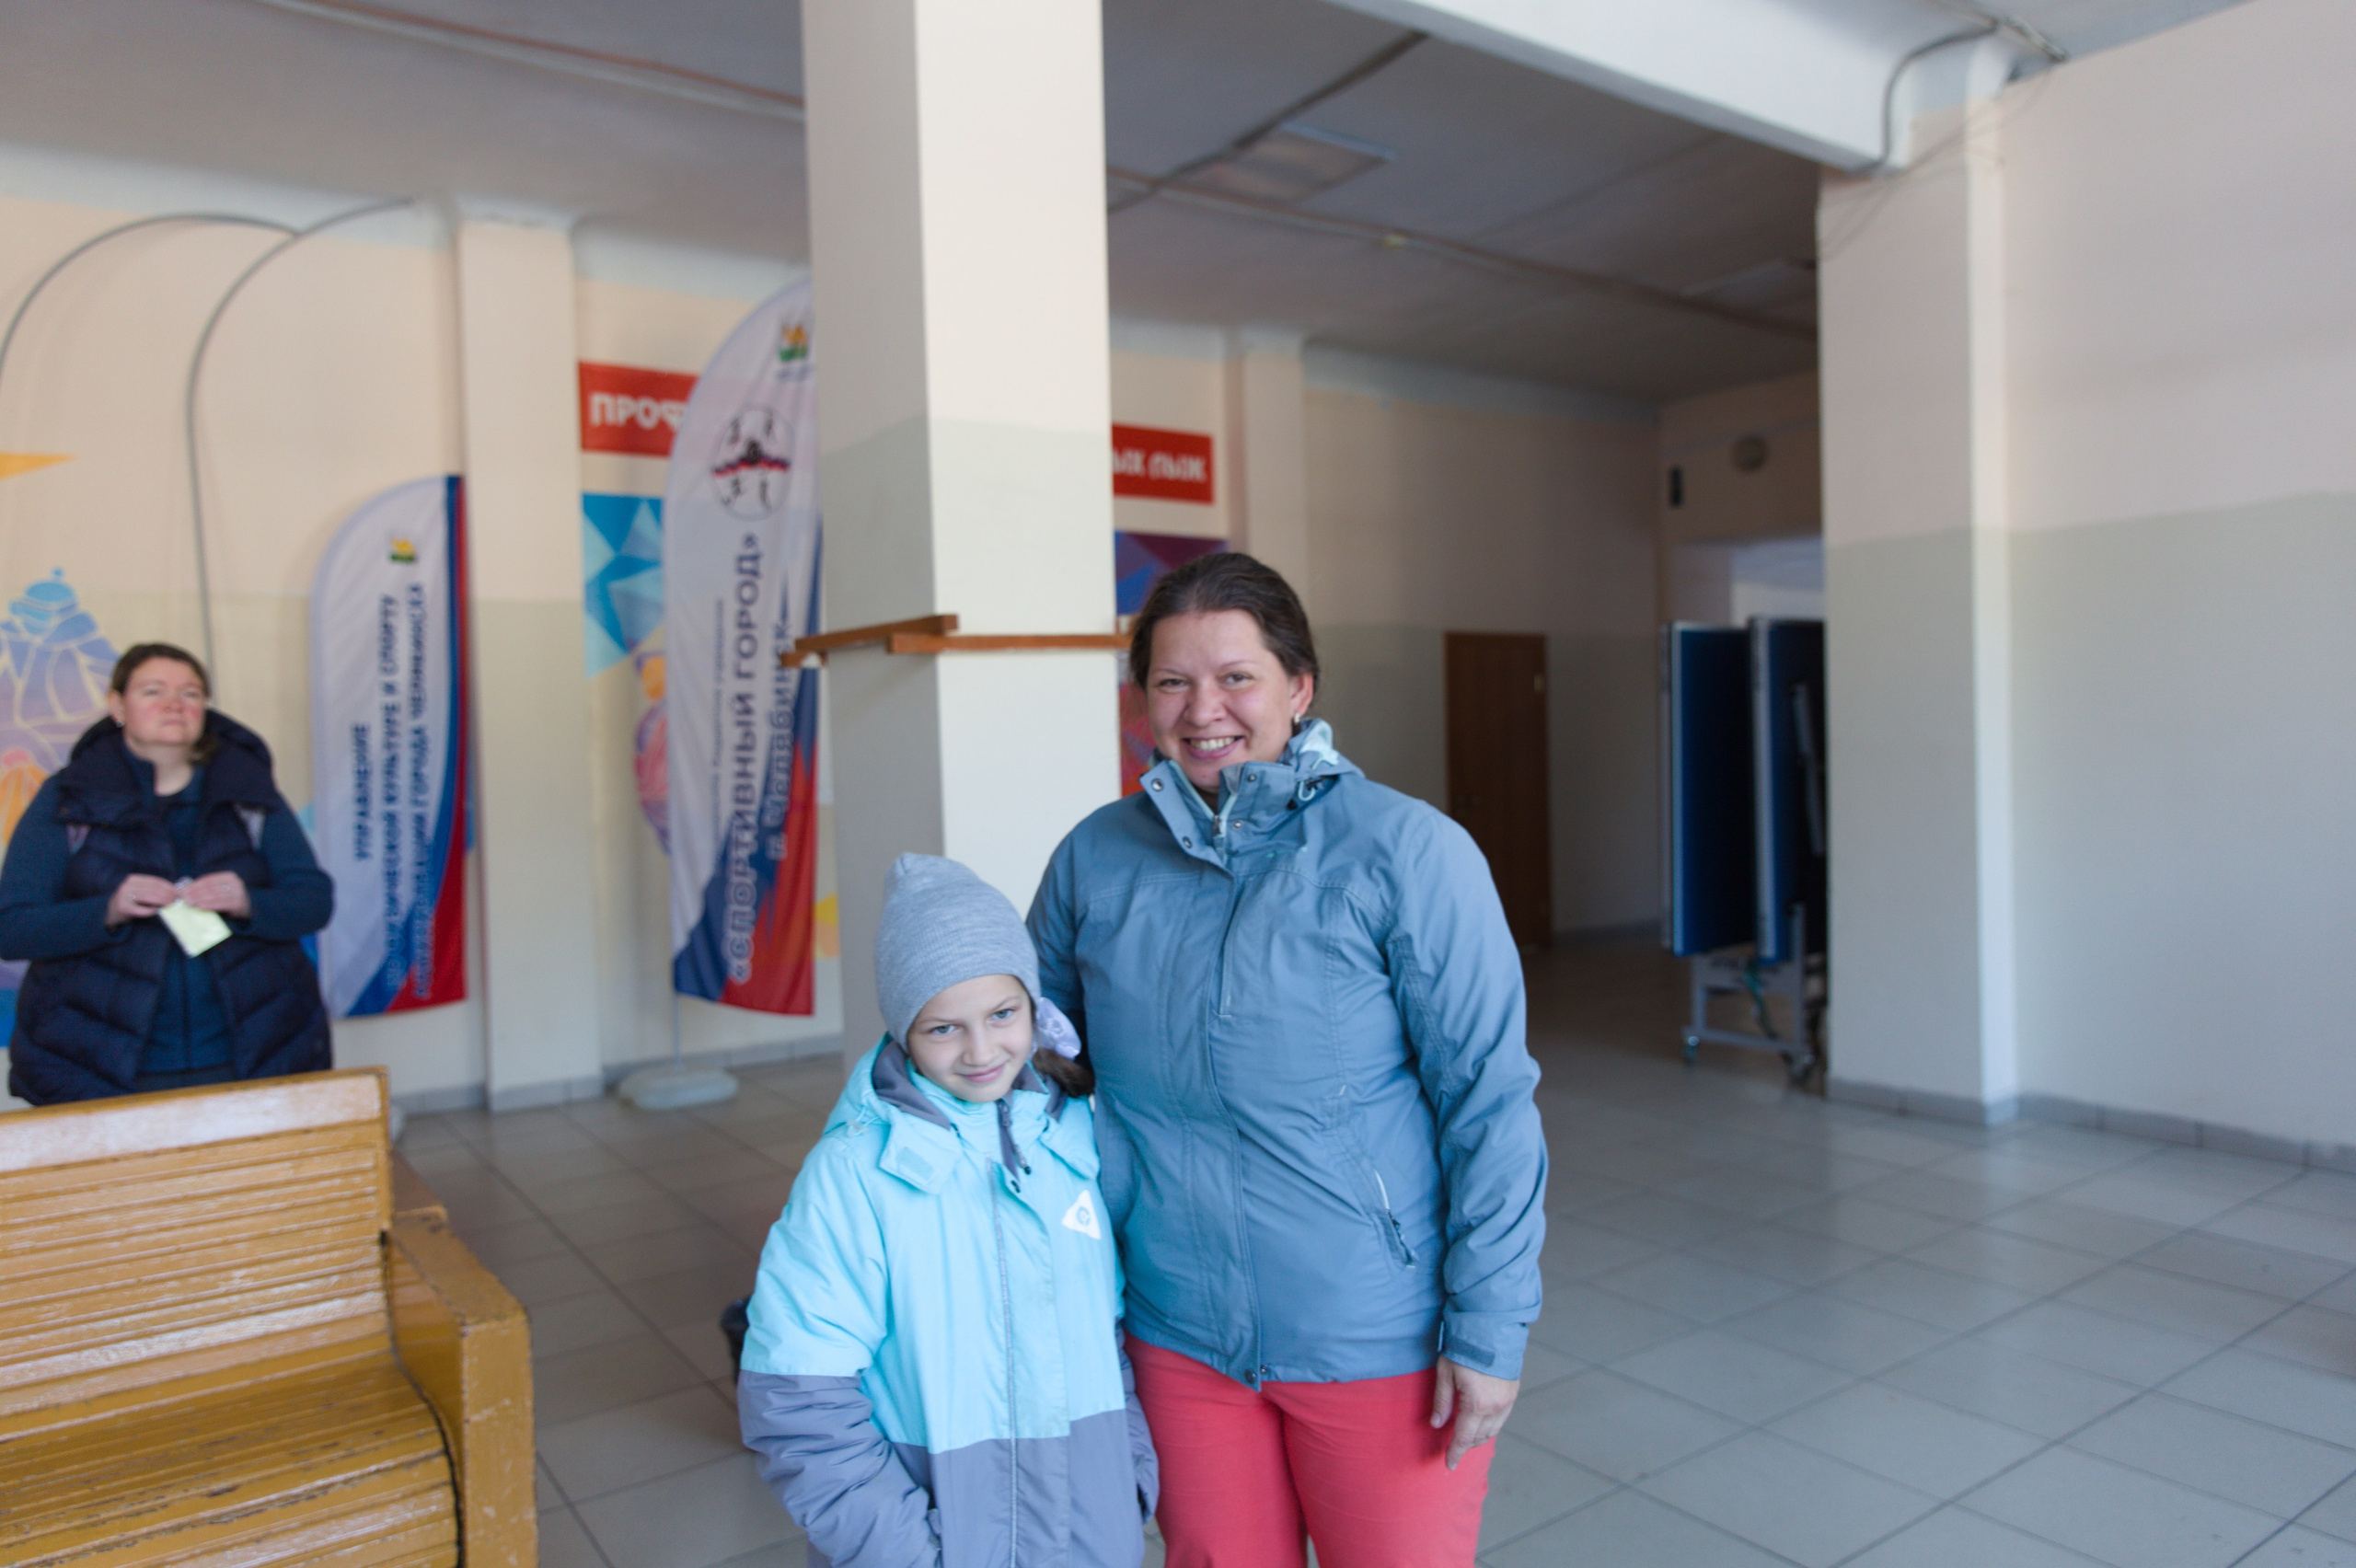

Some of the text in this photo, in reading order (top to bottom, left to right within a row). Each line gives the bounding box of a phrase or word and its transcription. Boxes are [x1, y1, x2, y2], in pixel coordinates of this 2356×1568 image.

[377, 594, 398, 675] СПОРТУ
[381, 682, 398, 696] И
[407, 582, 426, 720] ЧЕЛЯБИНСКА
[352, 724, 373, 861] УПРАВЛЕНИЕ
[380, 703, 399, 805] КУЛЬТУРЕ
[410, 726, 429, 806] ГОРОДА
[728, 534, 763, 979] «СПОРТИВНЫЙ ГОРОД»
[765, 622, 793, 826] Челябинск
[381, 812, 401, 951] ФИЗИЧЕСКОЙ
